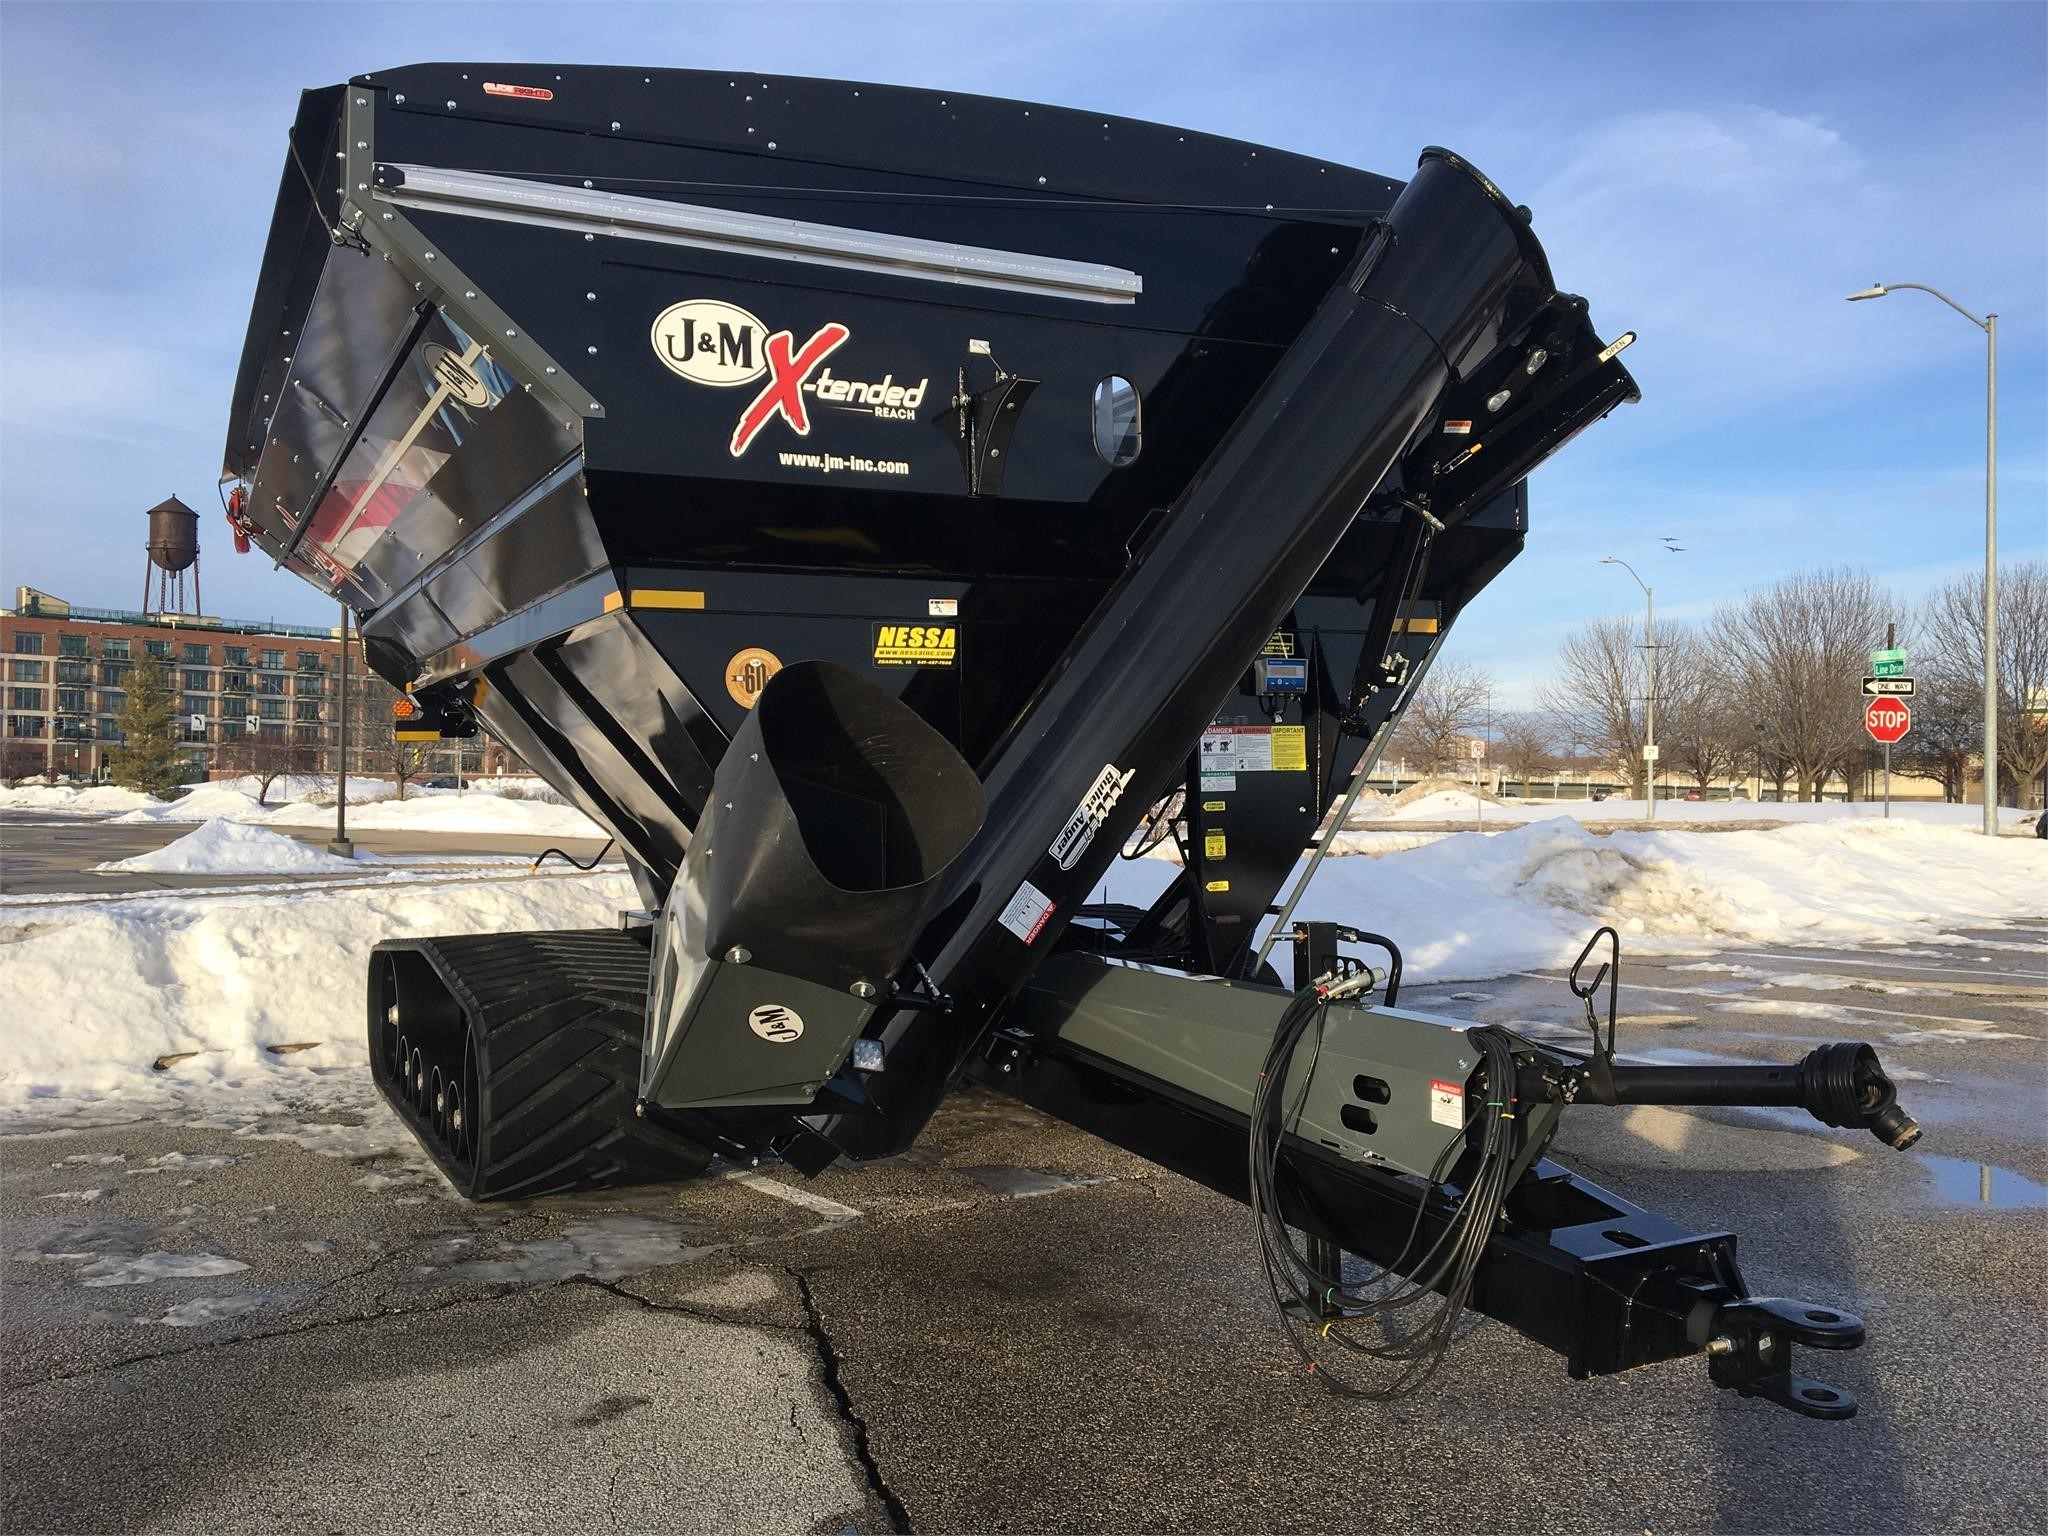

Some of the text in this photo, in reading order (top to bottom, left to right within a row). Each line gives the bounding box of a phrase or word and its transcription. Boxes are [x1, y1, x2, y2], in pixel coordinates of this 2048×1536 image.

[665, 318, 754, 369] J&M
[1606, 340, 1626, 356] OPEN
[874, 406, 915, 420] REACH
[779, 452, 909, 475] www.jm-inc.com
[877, 626, 956, 648] NESSA
[1877, 682, 1890, 690] ONE
[1868, 710, 1907, 728] STOP
[1057, 771, 1114, 855] Bullet Auger
[1025, 912, 1050, 944] DANGER
[754, 1007, 798, 1040] J&M
[1440, 1083, 1462, 1096] DANGER
